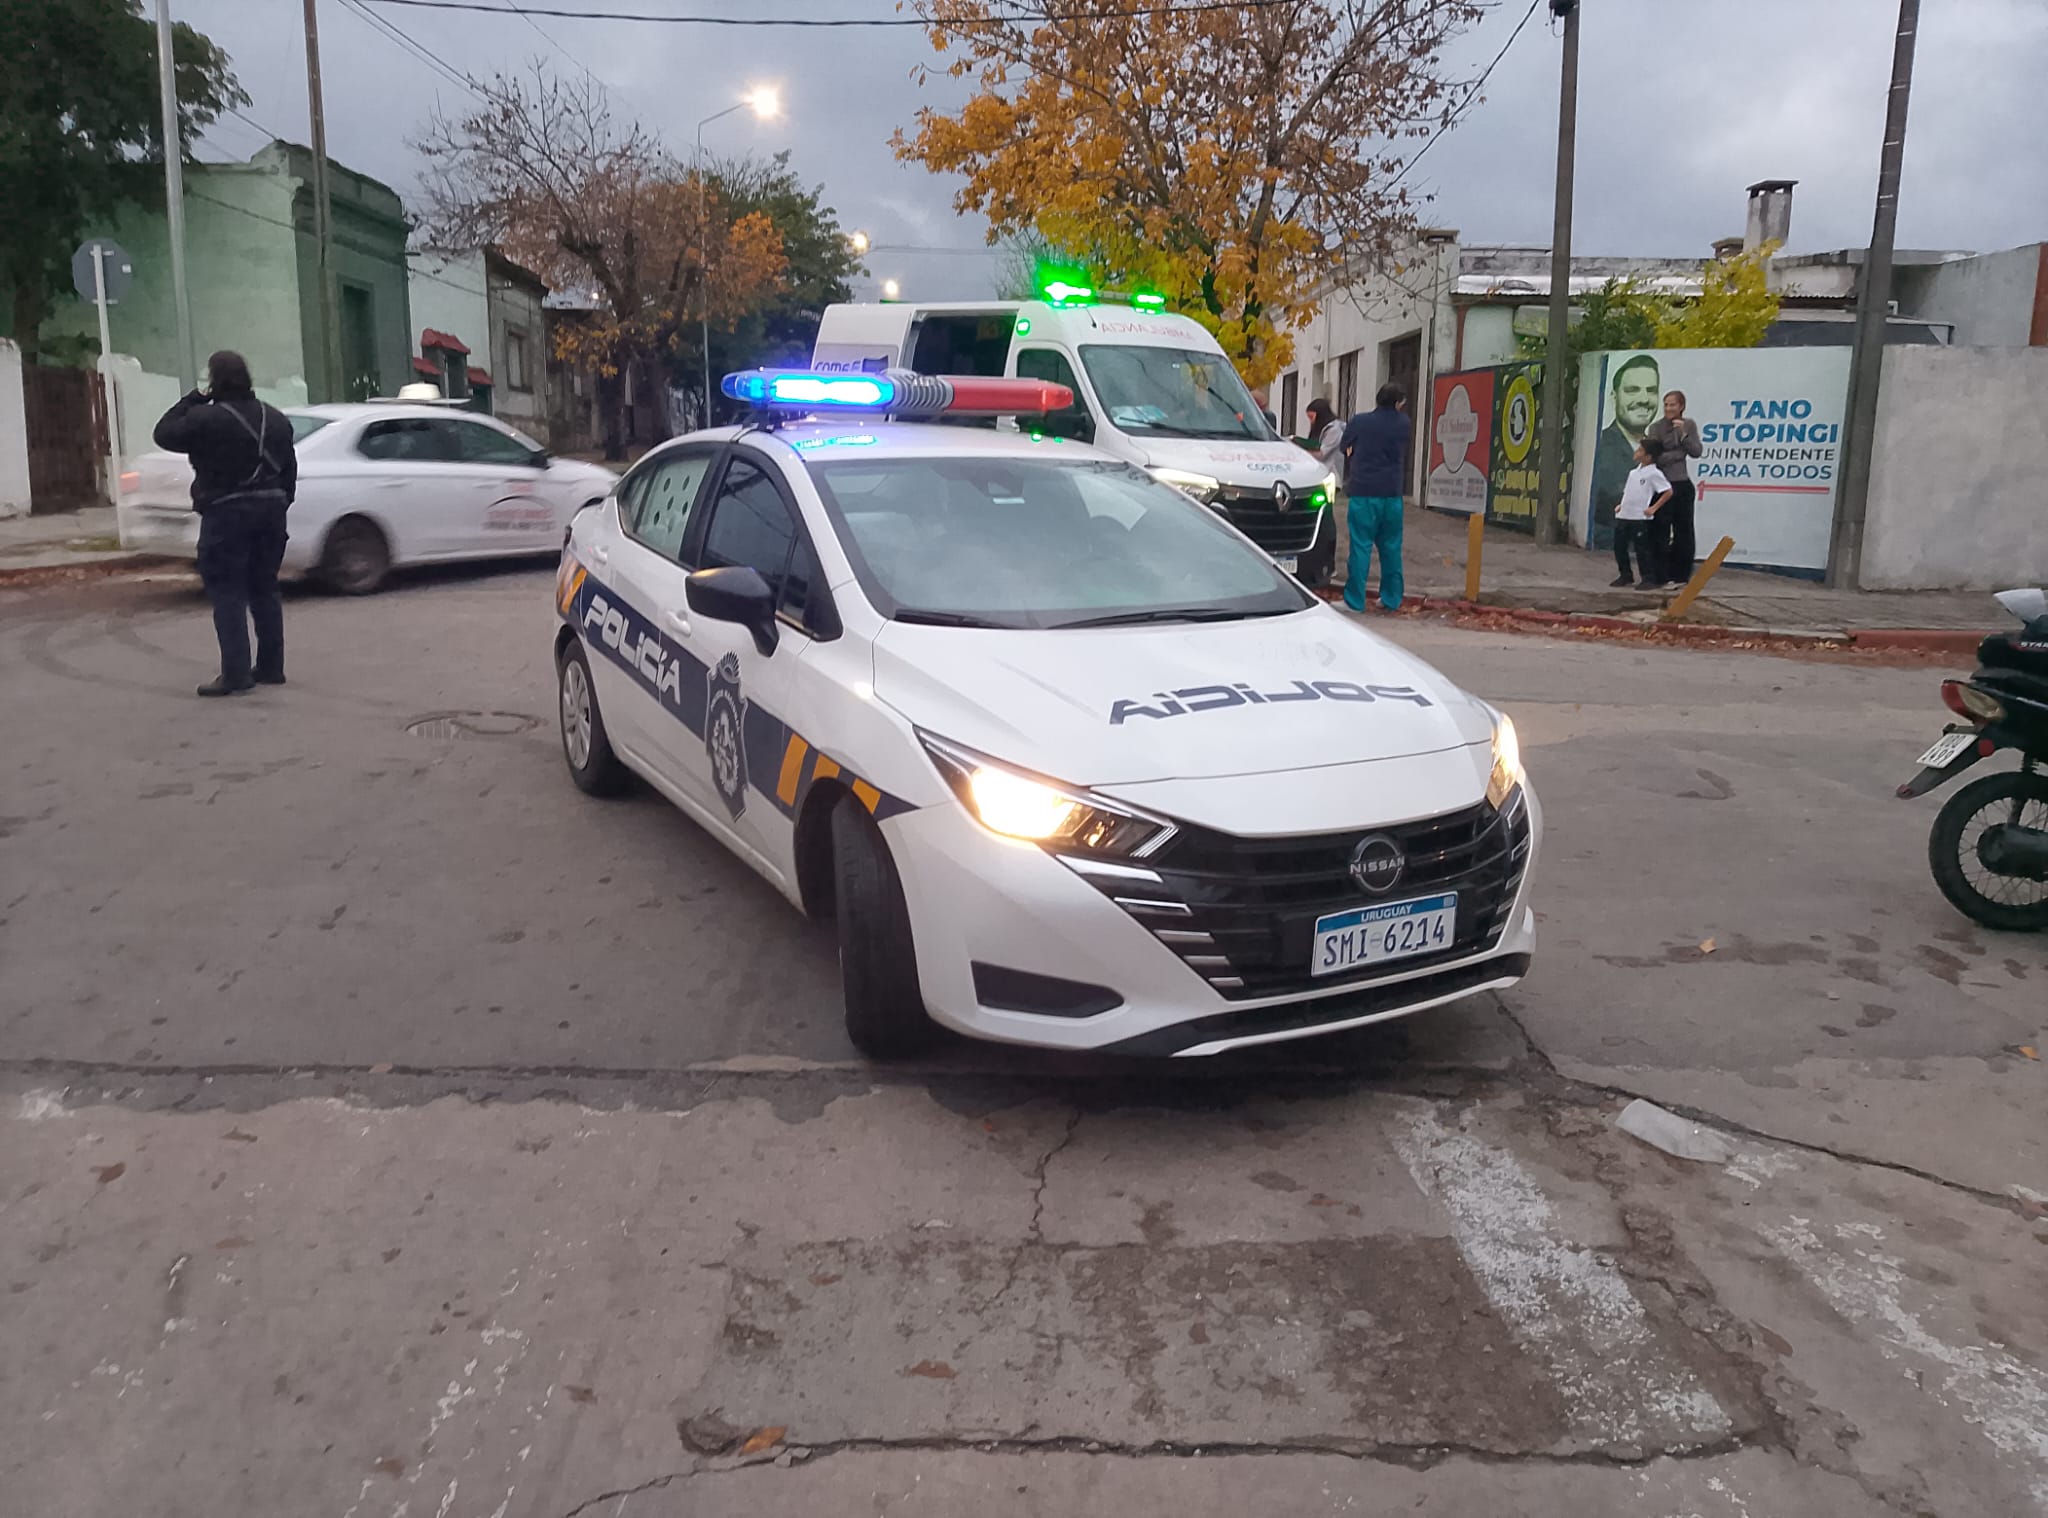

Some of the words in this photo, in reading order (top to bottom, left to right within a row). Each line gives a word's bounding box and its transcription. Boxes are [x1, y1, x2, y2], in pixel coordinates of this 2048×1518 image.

[1730, 400, 1812, 420] TANO
[1702, 423, 1838, 443] STOPINGI
[1701, 448, 1723, 460] UN
[1724, 448, 1835, 461] INTENDENTE
[1698, 463, 1751, 478] PARA
[1757, 464, 1832, 480] TODOS
[1350, 855, 1405, 874] NISSAN
[1360, 903, 1414, 923] URUGUAY
